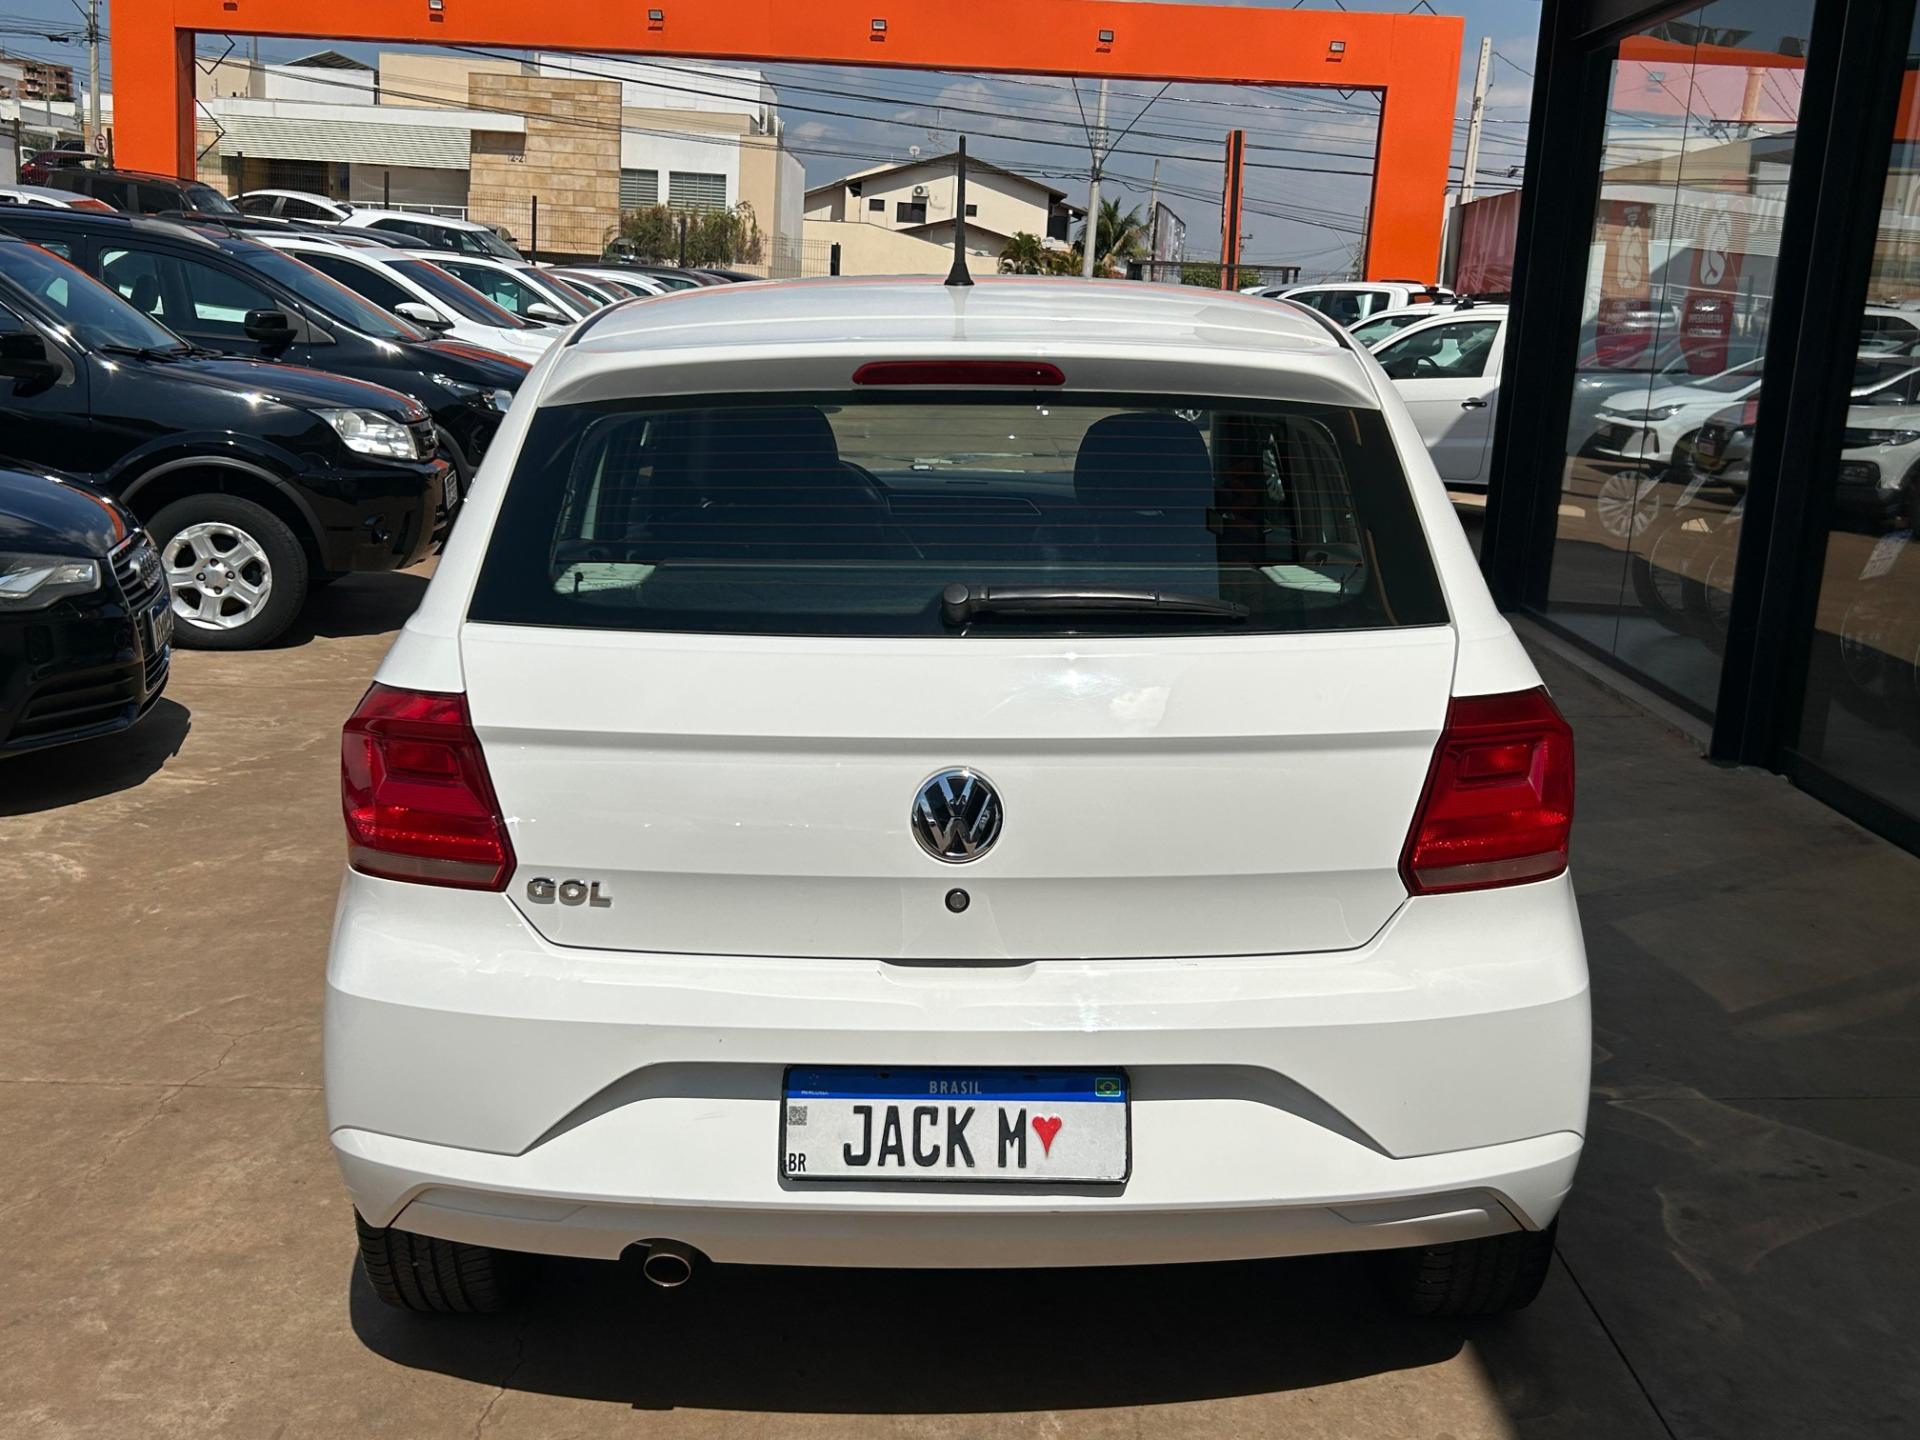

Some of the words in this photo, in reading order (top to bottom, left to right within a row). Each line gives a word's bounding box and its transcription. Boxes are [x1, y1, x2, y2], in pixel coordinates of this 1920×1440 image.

[526, 877, 613, 908] GOL
[928, 1080, 983, 1095] BRASIL
[843, 1105, 976, 1168] JACK
[788, 1152, 807, 1173] BR
